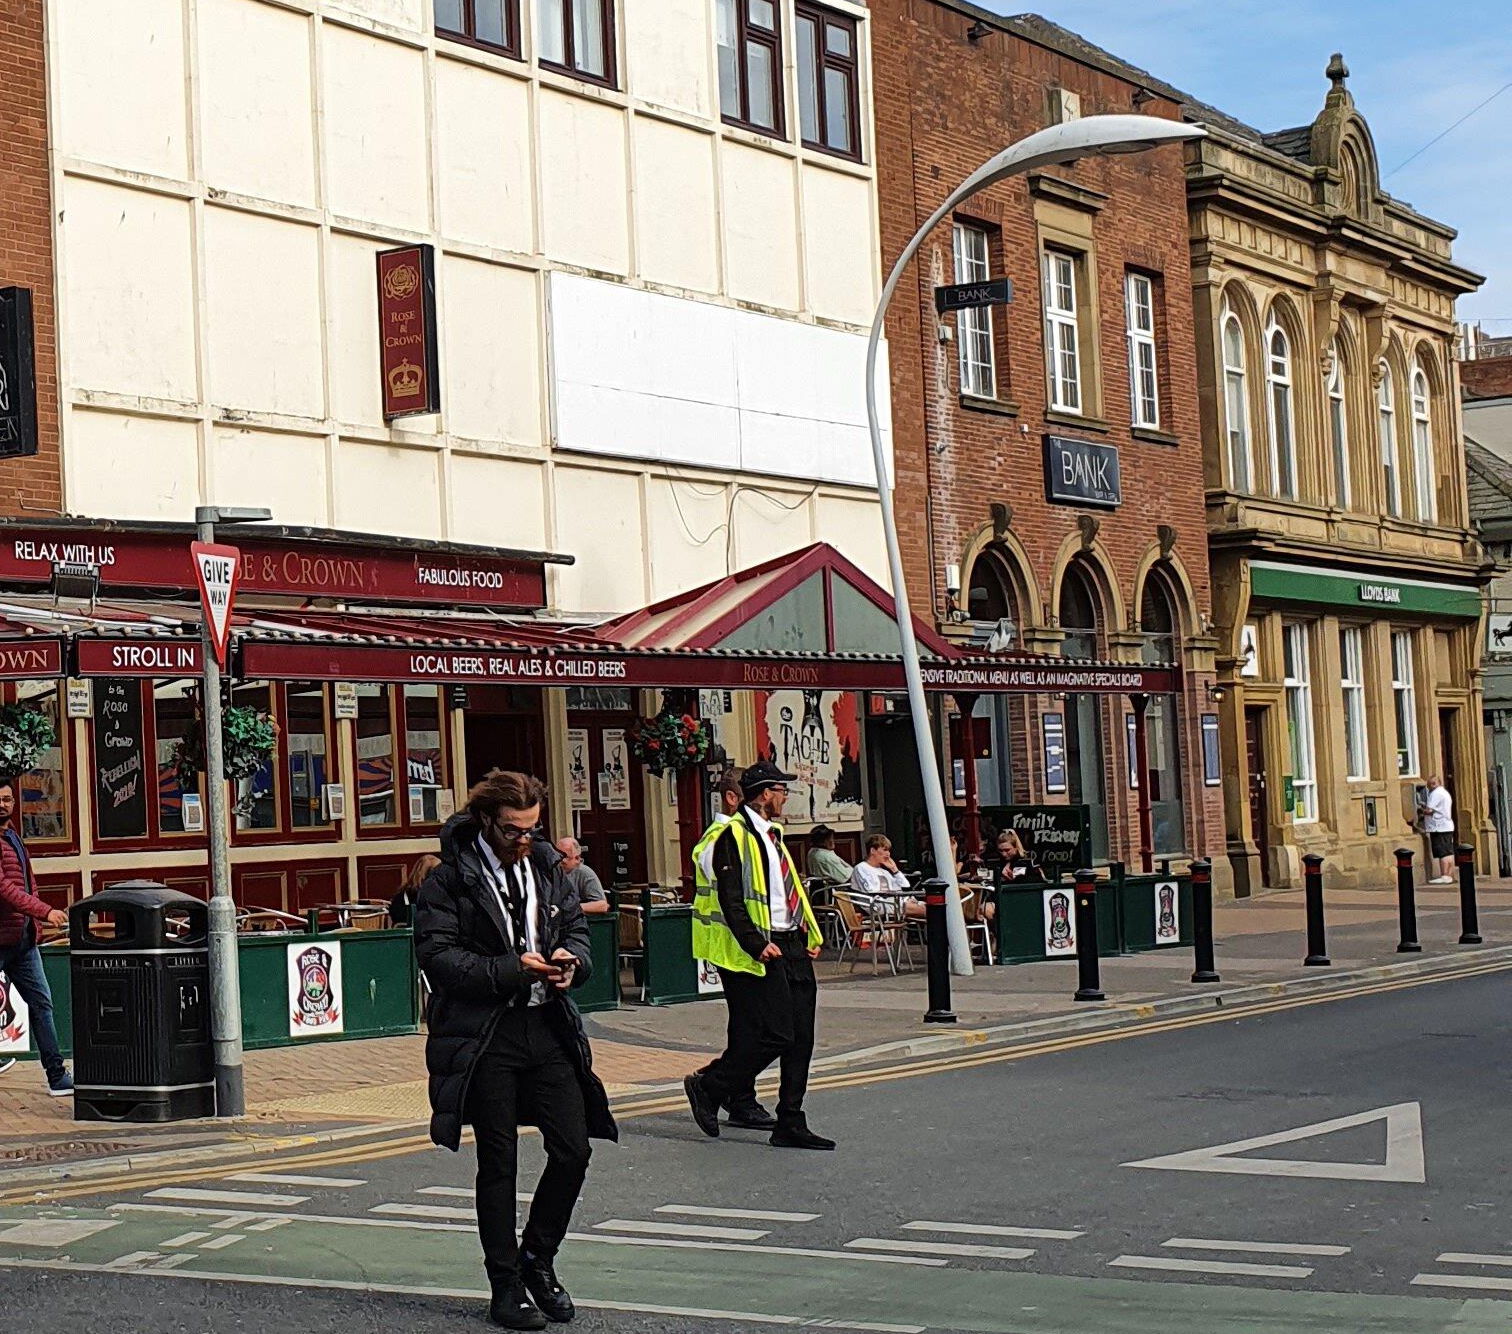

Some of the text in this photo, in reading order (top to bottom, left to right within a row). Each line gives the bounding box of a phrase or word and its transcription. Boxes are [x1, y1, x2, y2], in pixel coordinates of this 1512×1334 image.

[958, 287, 991, 302] BANK
[390, 310, 416, 323] ROSE
[385, 334, 422, 347] CROWN
[1061, 450, 1111, 491] BANK
[15, 541, 115, 565] RELAX WITH US
[203, 559, 230, 584] GIVE
[262, 557, 277, 581] &
[283, 551, 364, 589] CROWN
[418, 567, 503, 589] FABULOUS FOOD
[210, 589, 227, 605] WAY
[1360, 584, 1401, 603] LLOYDS BANK
[112, 646, 195, 668] STROLL IN
[410, 655, 626, 678] LOCAL BEERS, REAL ALES & CHILLED BEERS
[744, 664, 819, 683] ROSE & CROWN
[921, 669, 944, 682] ENSIVE
[945, 669, 988, 684] TRADITIONAL
